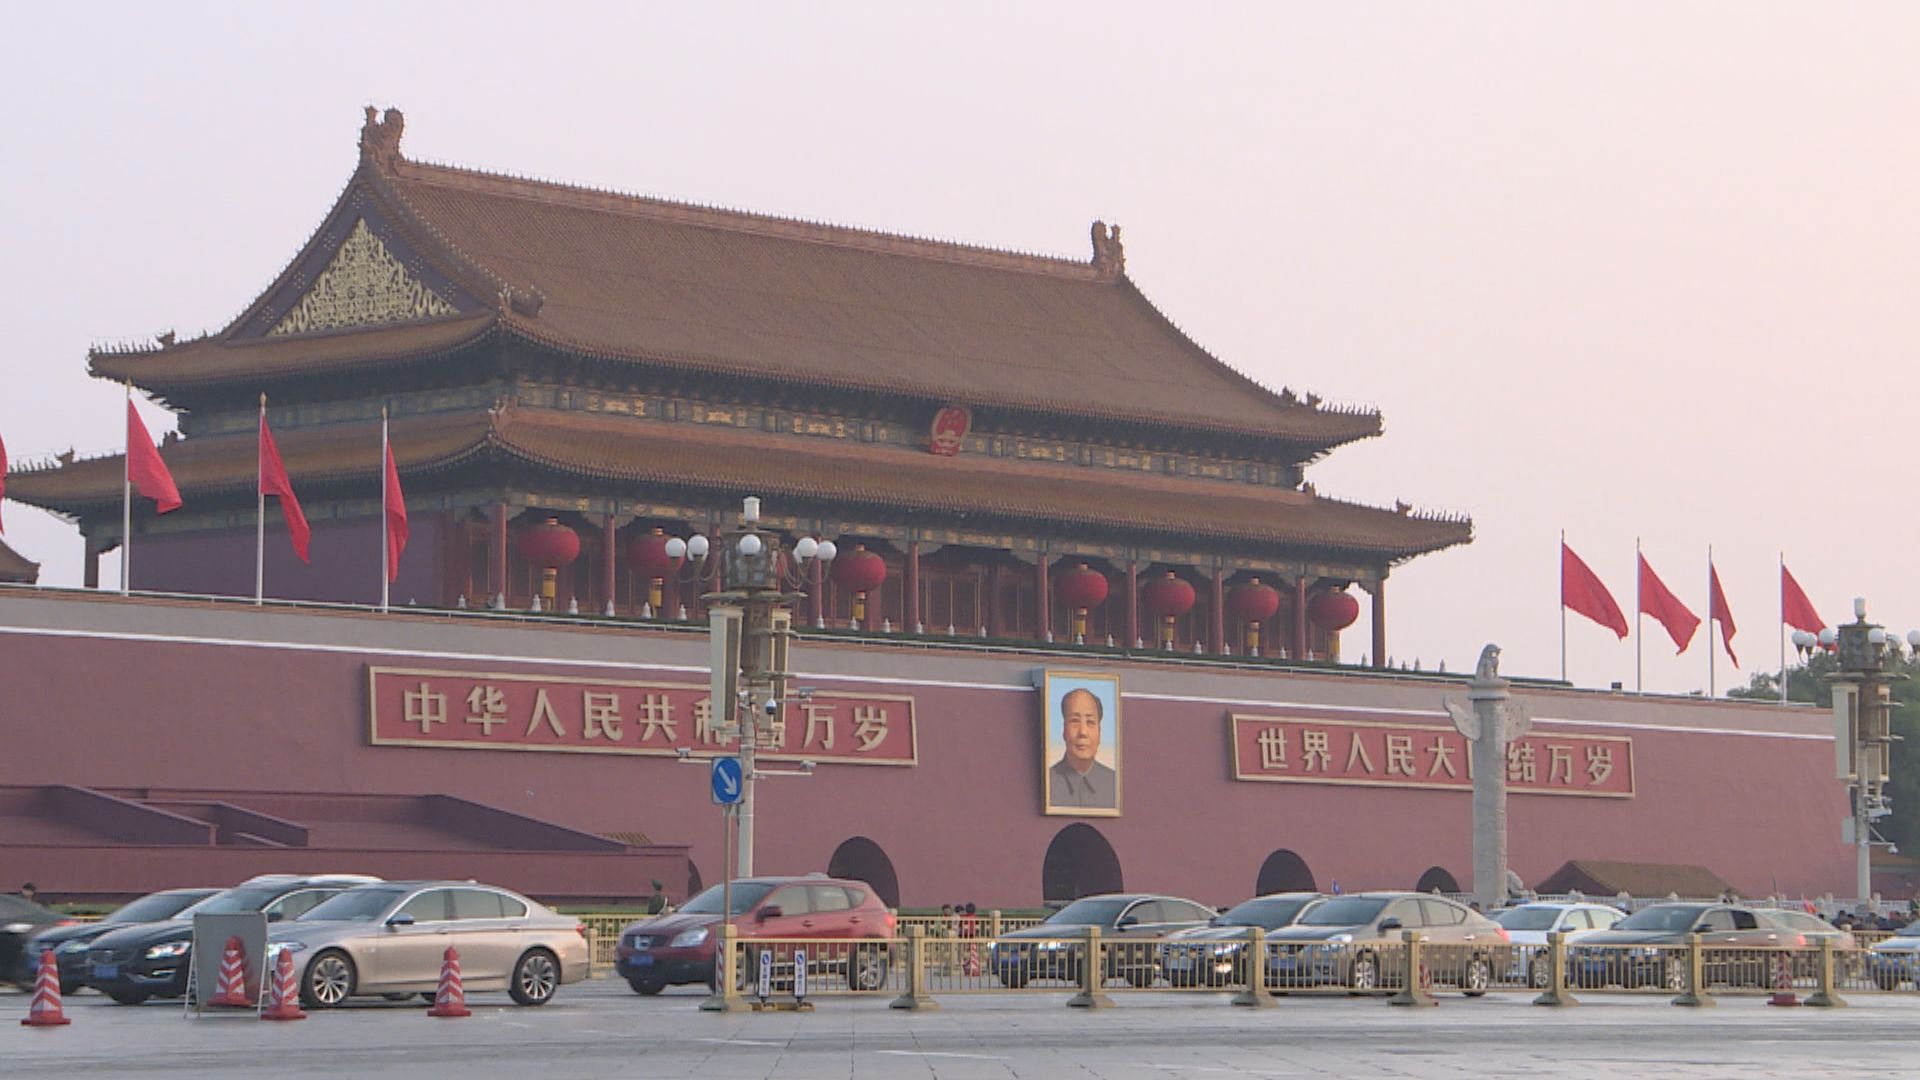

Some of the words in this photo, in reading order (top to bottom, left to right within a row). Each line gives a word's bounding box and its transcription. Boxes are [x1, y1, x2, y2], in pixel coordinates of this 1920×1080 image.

[403, 683, 889, 751] 中华人民共和万岁
[1257, 727, 1614, 786] 世界人民大结万岁
